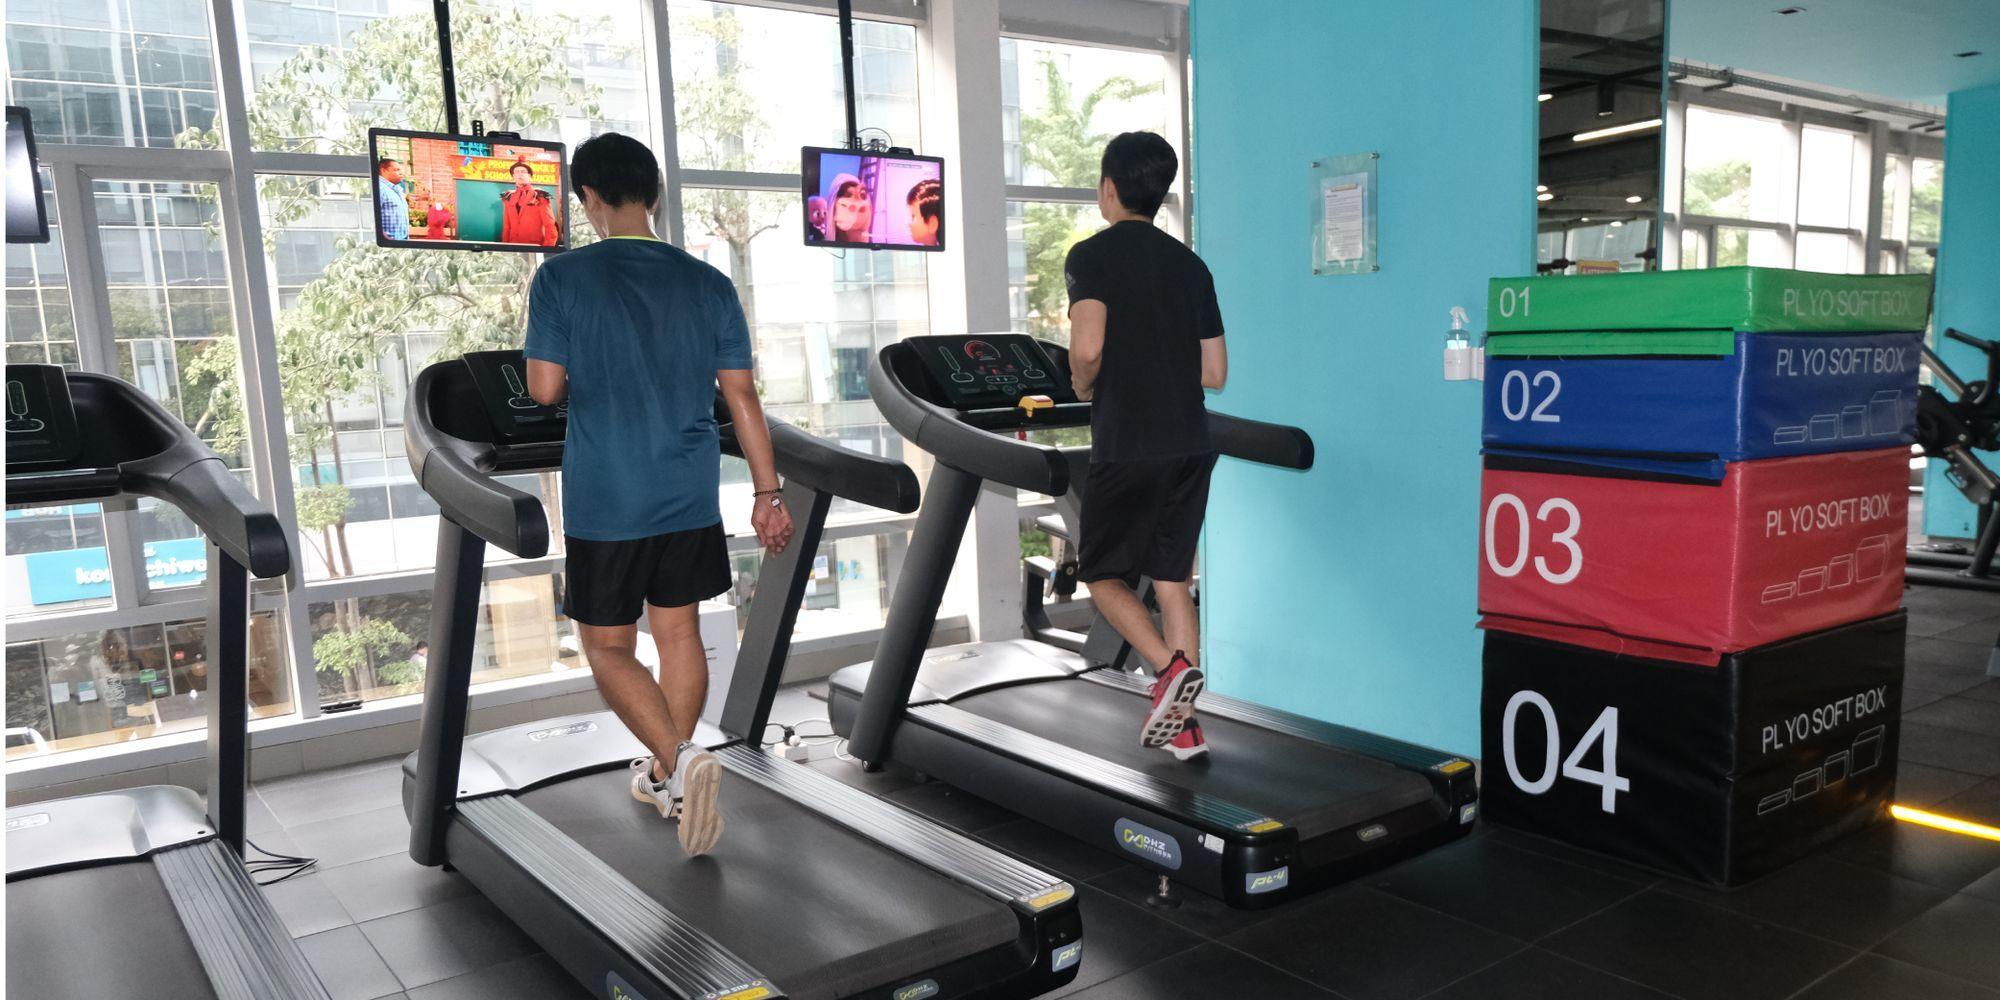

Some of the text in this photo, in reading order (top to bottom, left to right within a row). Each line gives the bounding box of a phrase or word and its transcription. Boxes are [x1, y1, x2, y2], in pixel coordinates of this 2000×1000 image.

[1500, 287, 1530, 318] 01
[1837, 290, 1880, 316] SOFT
[1881, 290, 1912, 316] BOX
[1828, 348, 1872, 375] SOFT
[1873, 347, 1906, 373] BOX
[1501, 370, 1562, 422] 02
[1816, 498, 1858, 529] SOFT
[1860, 493, 1891, 521] BOX
[1485, 493, 1583, 584] 03
[1812, 697, 1854, 734] SOFT
[1855, 685, 1887, 718] BOX
[1502, 690, 1630, 814] 04
